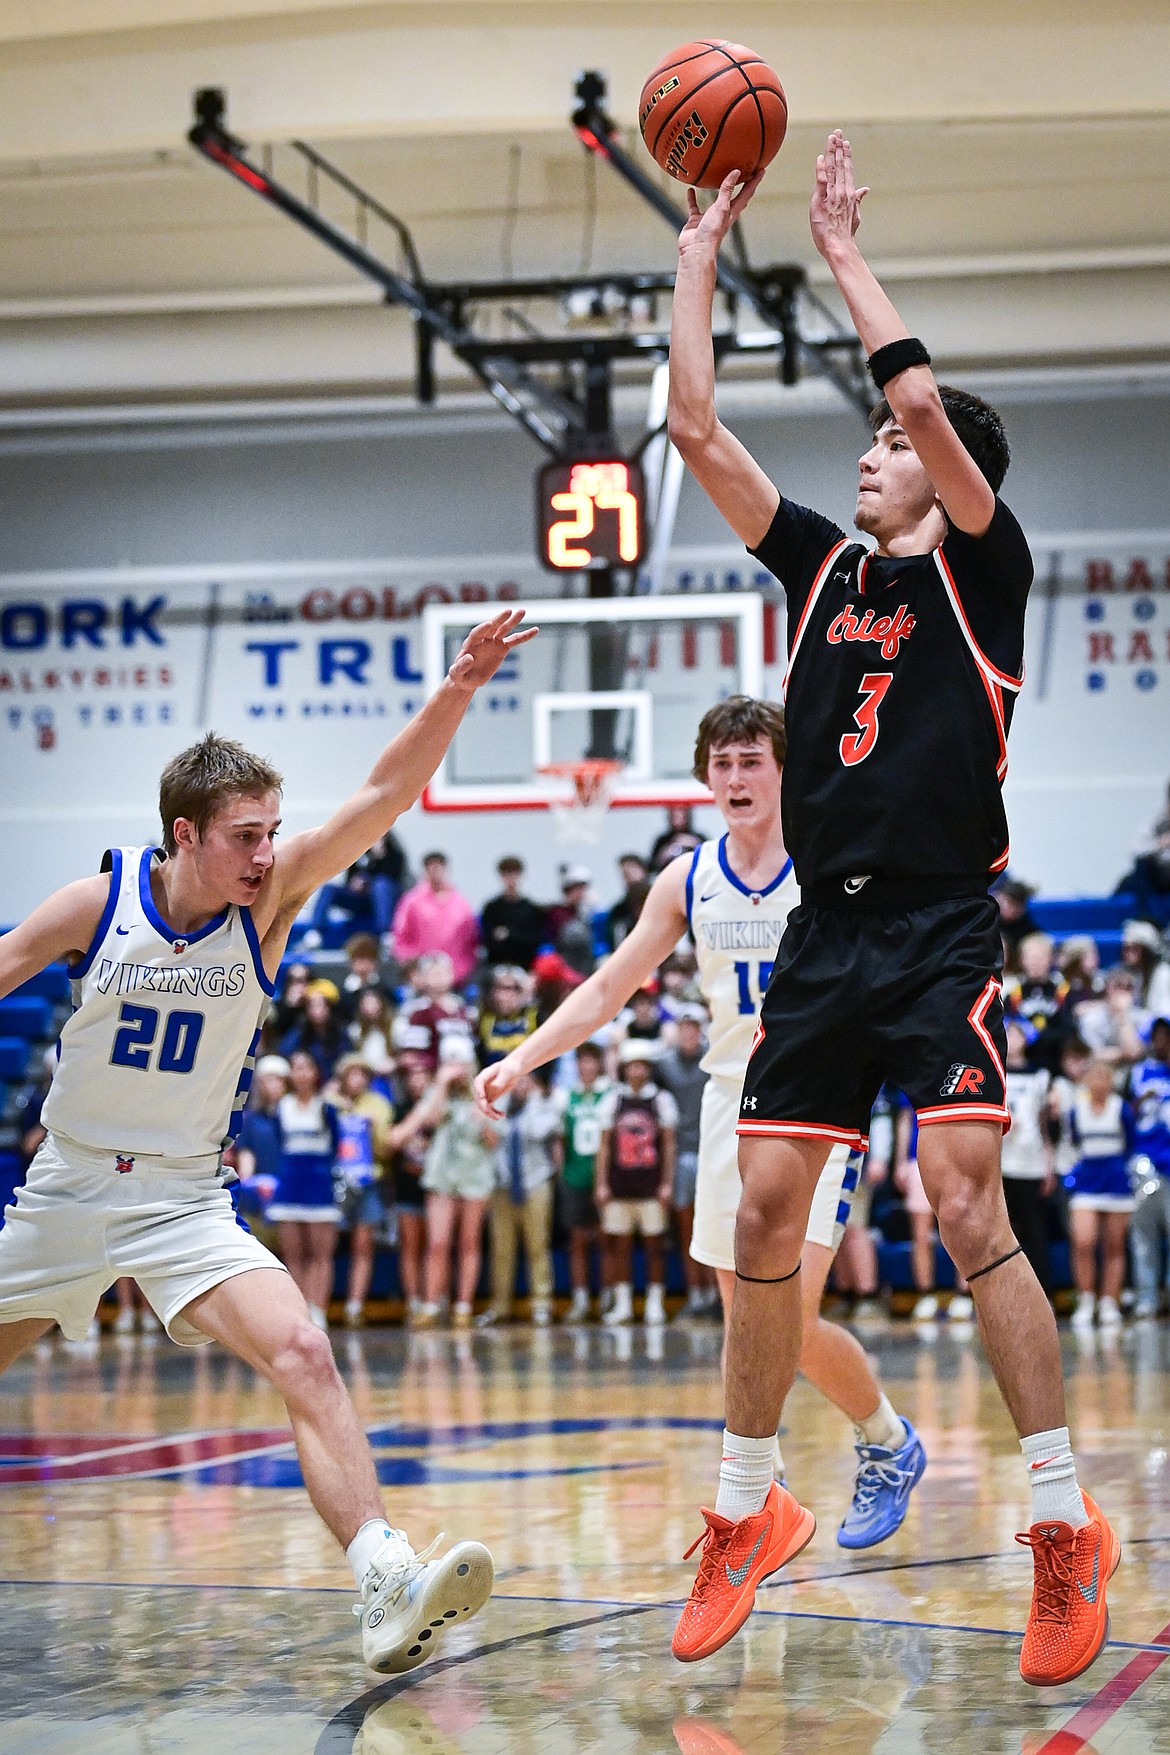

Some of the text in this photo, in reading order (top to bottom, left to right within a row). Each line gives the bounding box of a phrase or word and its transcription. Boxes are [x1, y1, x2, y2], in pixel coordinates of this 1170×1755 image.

[548, 493, 638, 568] 27
[838, 672, 894, 768] 3
[702, 920, 783, 951] VIKIN
[97, 959, 246, 997] VIKINGS
[108, 1000, 206, 1075] 20
